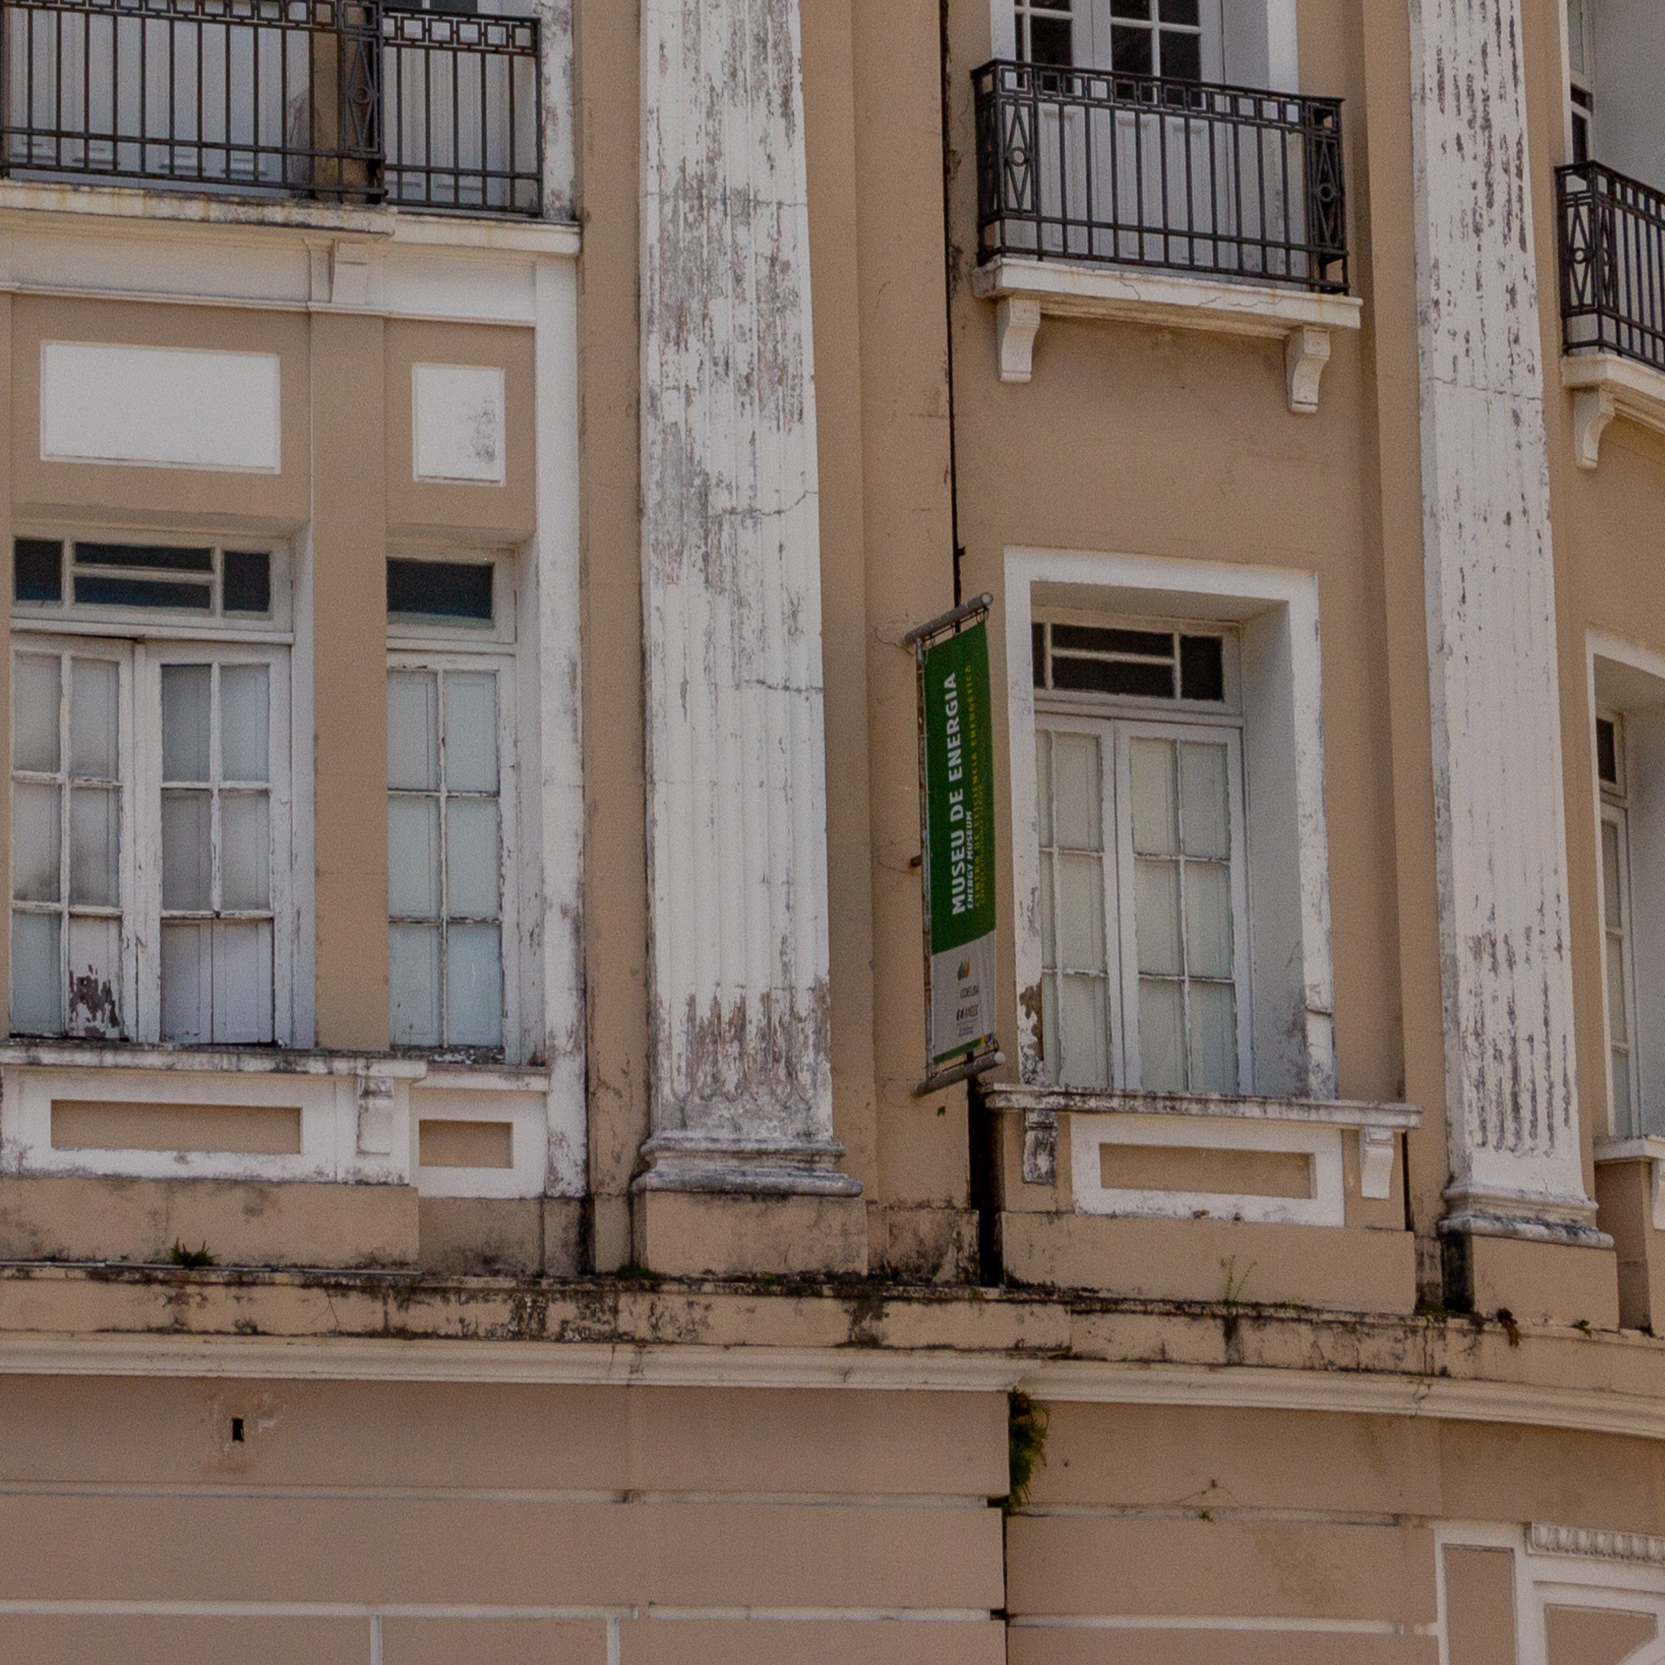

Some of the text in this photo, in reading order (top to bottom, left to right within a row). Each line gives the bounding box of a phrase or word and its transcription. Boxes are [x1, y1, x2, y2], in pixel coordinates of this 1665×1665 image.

[943, 671, 966, 915] MUSEU DE ENERGIA
[966, 811, 974, 909] ENERGY MUSEUM
